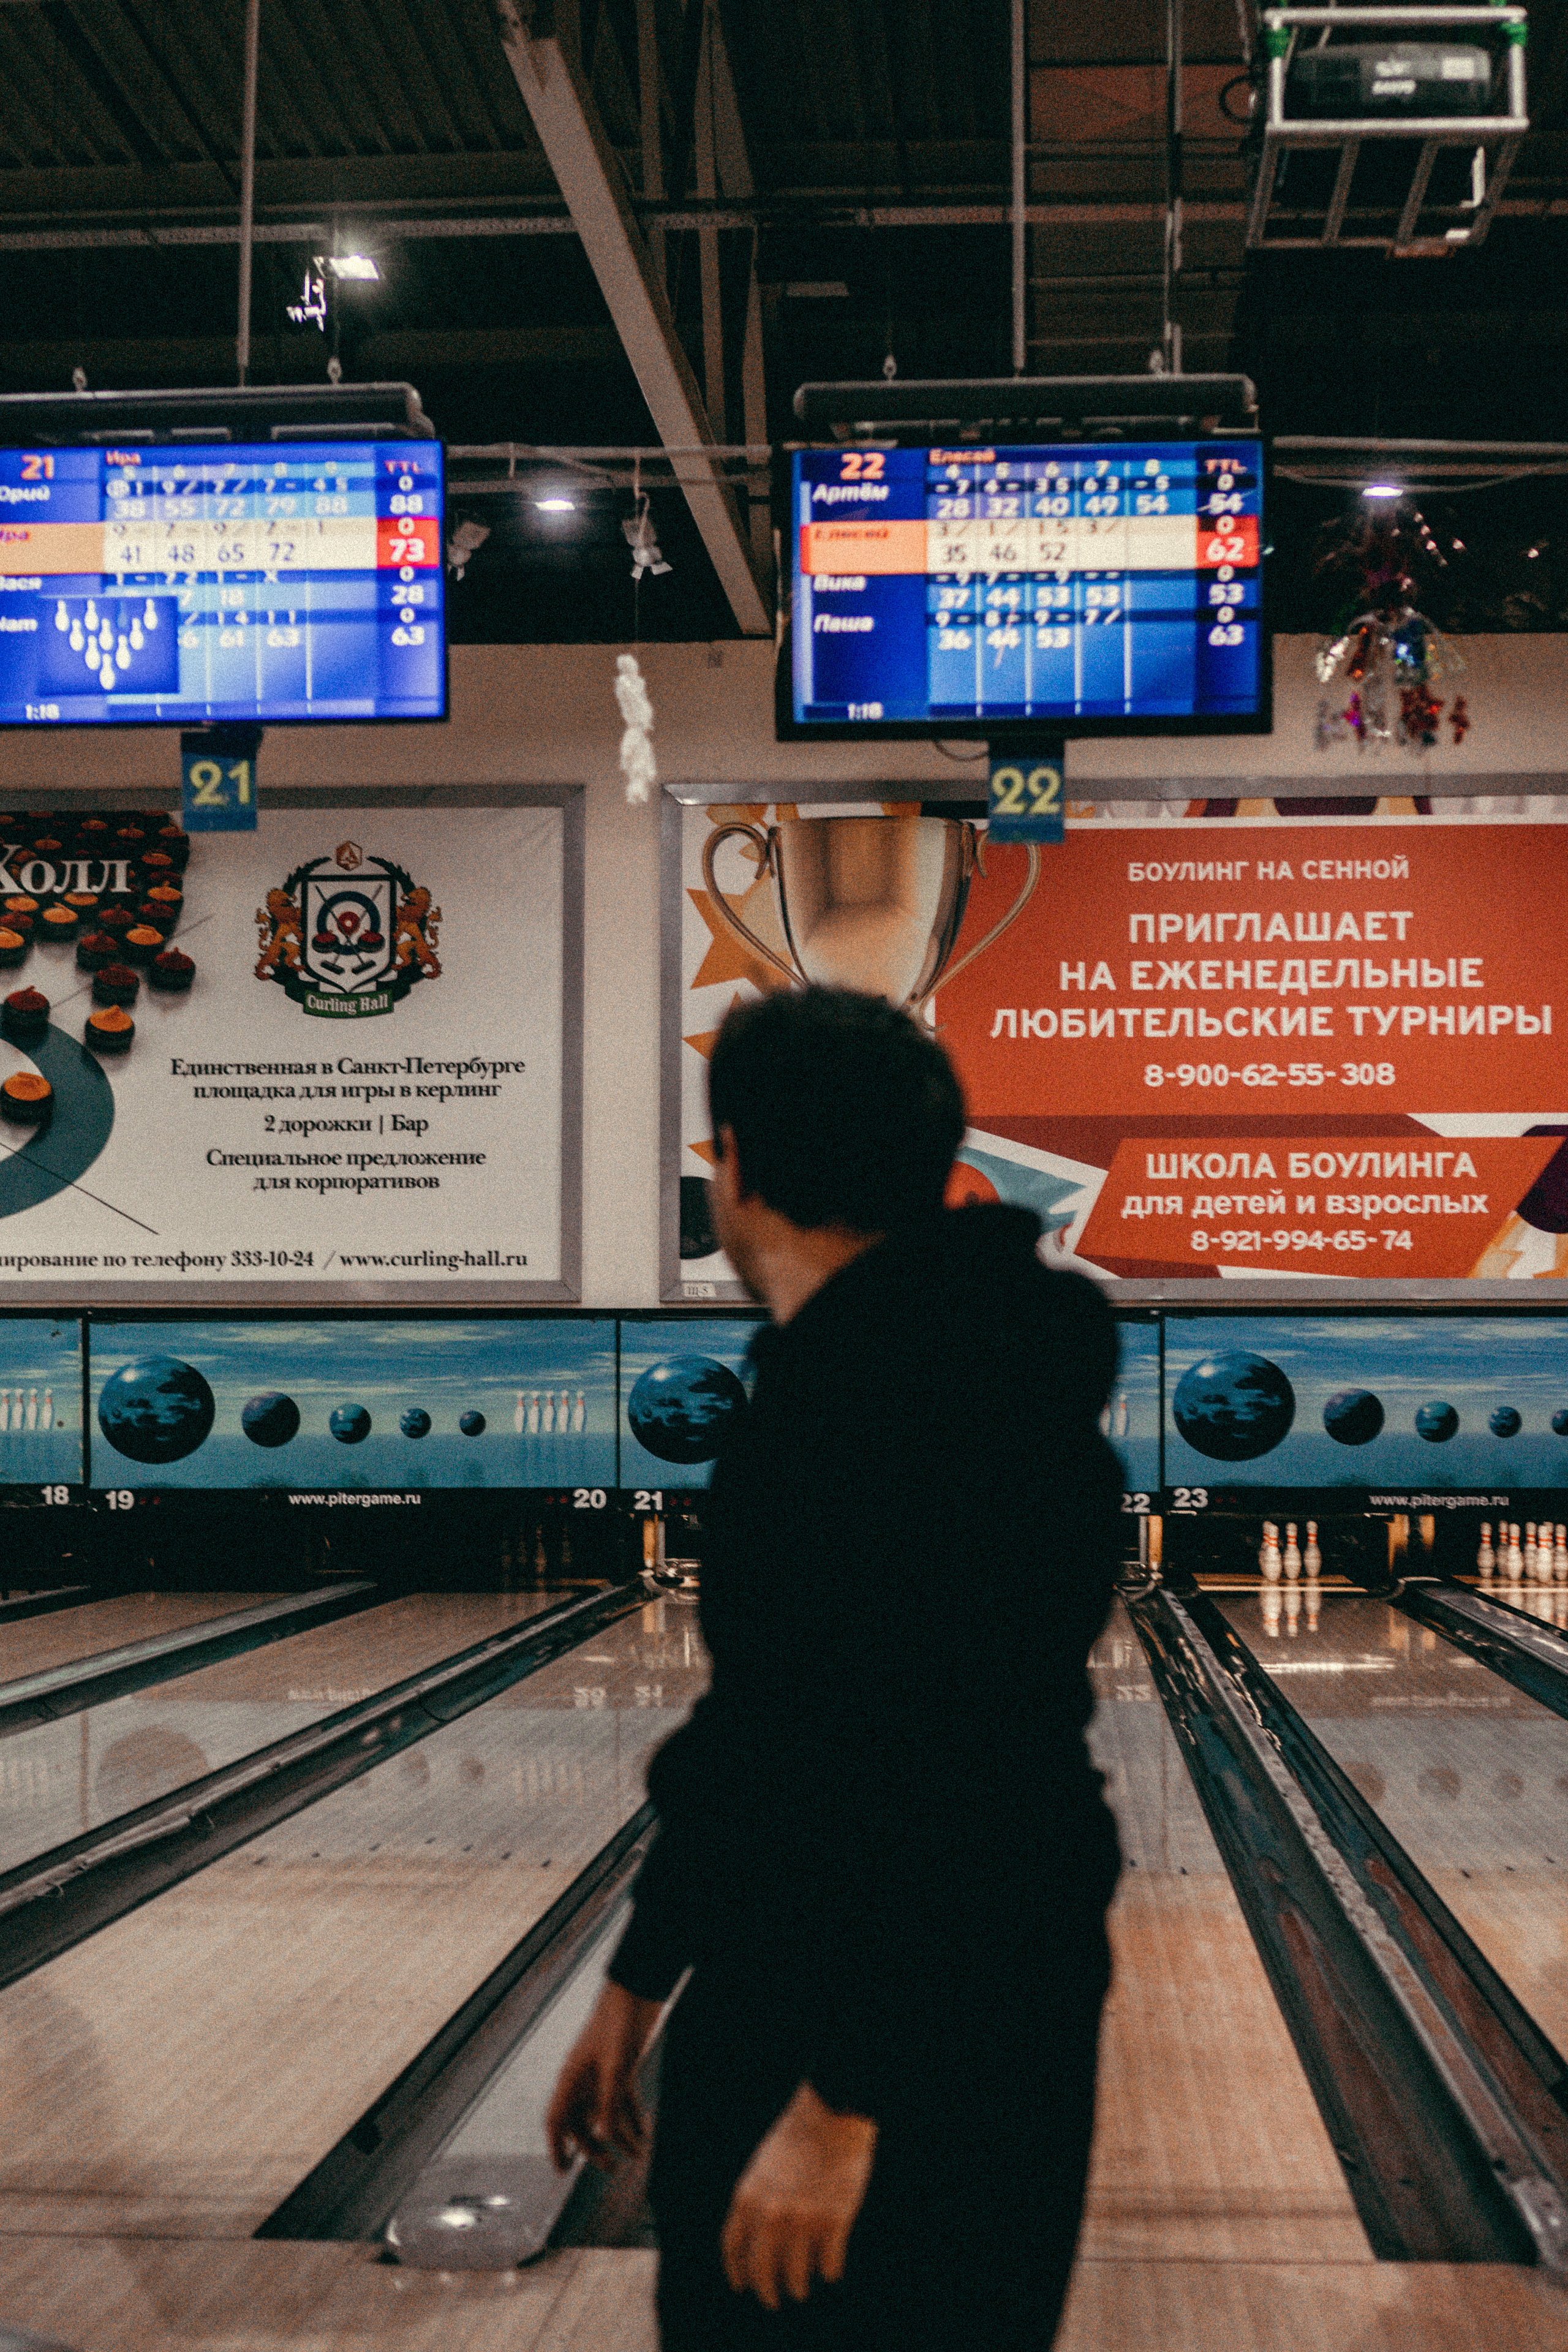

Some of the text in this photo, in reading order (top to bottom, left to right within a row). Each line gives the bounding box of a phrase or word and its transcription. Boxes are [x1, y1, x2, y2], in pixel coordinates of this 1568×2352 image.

[21, 454, 55, 481] 21
[840, 452, 886, 480] 22
[1096, 460, 1110, 477] 7
[398, 475, 413, 491] 0
[1217, 473, 1234, 491] 0
[390, 494, 424, 514] 88
[812, 483, 889, 505] Артём
[936, 492, 1244, 519] 28 32 40 49 54 54
[397, 516, 415, 535] 0
[1216, 515, 1235, 534] 0
[216, 542, 246, 563] 65
[268, 541, 296, 562] 72
[388, 538, 425, 562] 73
[1206, 537, 1245, 562] 62
[399, 565, 415, 582] 0
[1216, 564, 1234, 582] 0
[390, 584, 425, 606] 28
[938, 582, 1245, 609] 37 44 53 53 53
[399, 606, 416, 624] 0
[813, 613, 875, 633] Паша
[1216, 605, 1234, 624] 0
[266, 627, 301, 649] 63
[390, 625, 426, 647] 63
[938, 624, 1245, 650] 36 44 53 63
[189, 760, 250, 805] 21
[991, 767, 1061, 815] 22
[1128, 854, 1409, 883] БОУЛИНГ НА СЕННОЙ
[1129, 910, 1414, 944] ПРИГЛАШАЕТ
[1059, 957, 1485, 996] НА ЕЖЕНЕДЕЛЬНЫЕ
[307, 993, 389, 1015] Curling Hall
[990, 1004, 1553, 1039] ЛЮБИТЕЛЬСКИЕ ТУРНИРЫ
[170, 1057, 526, 1079] Единственная в Санкт-Петербурге
[1144, 1063, 1396, 1087] 8-900-62-55-308
[193, 1084, 502, 1103] площадка для игры в керлинг
[264, 1115, 276, 1133] 2
[279, 1118, 372, 1137] дорожки
[391, 1115, 429, 1137] Бар
[206, 1148, 486, 1171] Специальное предложение
[1146, 1151, 1479, 1180] ШКОЛА БОУЛИНГА
[253, 1175, 441, 1195] для корпоративов
[1120, 1188, 1489, 1220] для детей и взрослых
[1190, 1229, 1414, 1252] 8-921-994-65-74
[0, 1254, 98, 1272] ирование
[104, 1255, 127, 1267] по
[131, 1251, 227, 1272] телефону
[230, 1250, 314, 1267] 333-10-24
[339, 1250, 529, 1272] www.curling-hall.ru
[40, 1485, 70, 1505] 18
[105, 1490, 135, 1510] 19
[288, 1491, 421, 1508] www.pitergame.ru
[573, 1488, 608, 1509] 20
[633, 1490, 664, 1510] 21
[1121, 1493, 1151, 1513] 22
[1172, 1487, 1208, 1509] 23
[1368, 1493, 1510, 1509] www.pitergame.ru
